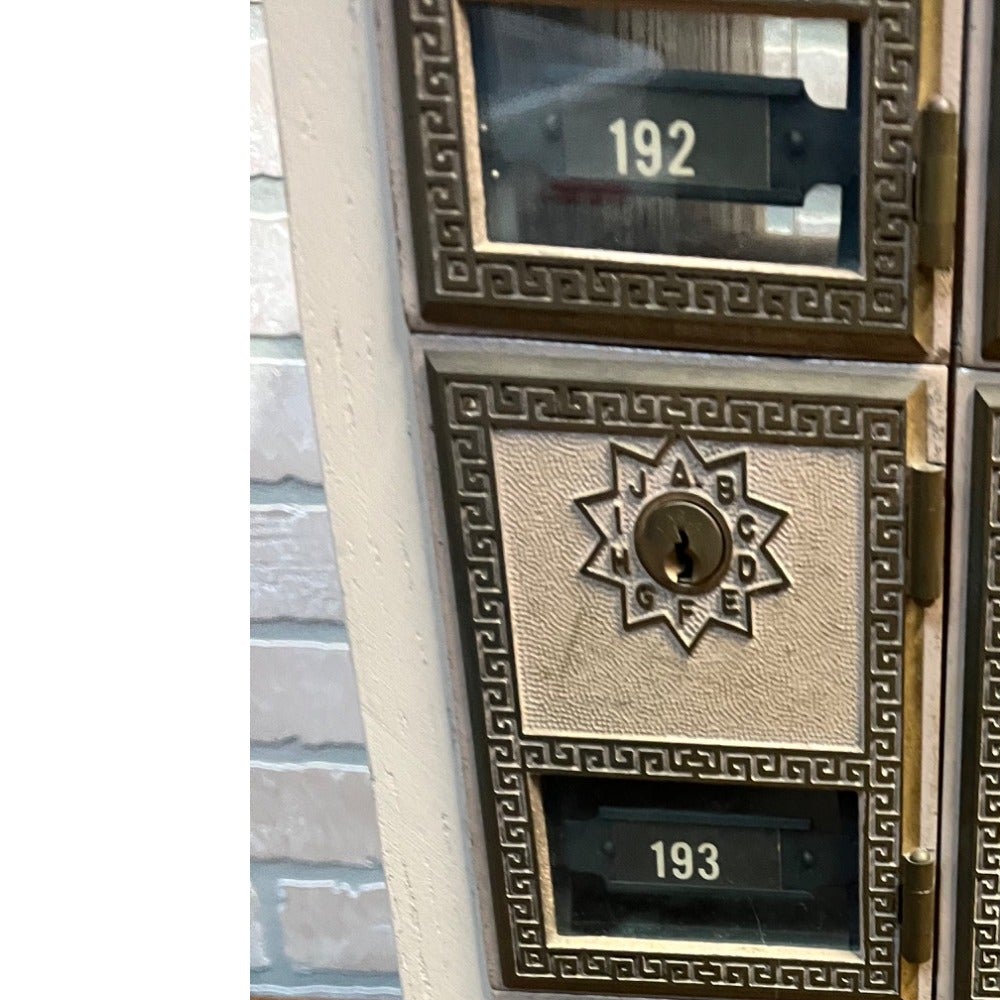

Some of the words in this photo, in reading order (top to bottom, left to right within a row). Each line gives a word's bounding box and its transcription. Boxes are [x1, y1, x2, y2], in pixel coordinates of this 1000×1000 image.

[609, 118, 695, 178] 192
[628, 468, 646, 498] J
[671, 458, 695, 487] A
[716, 473, 735, 504] B
[737, 514, 757, 542] C
[611, 544, 630, 575] H
[738, 553, 757, 584] D
[636, 584, 656, 610] G
[678, 599, 696, 625] F
[721, 586, 741, 614] E
[650, 840, 720, 881] 193
